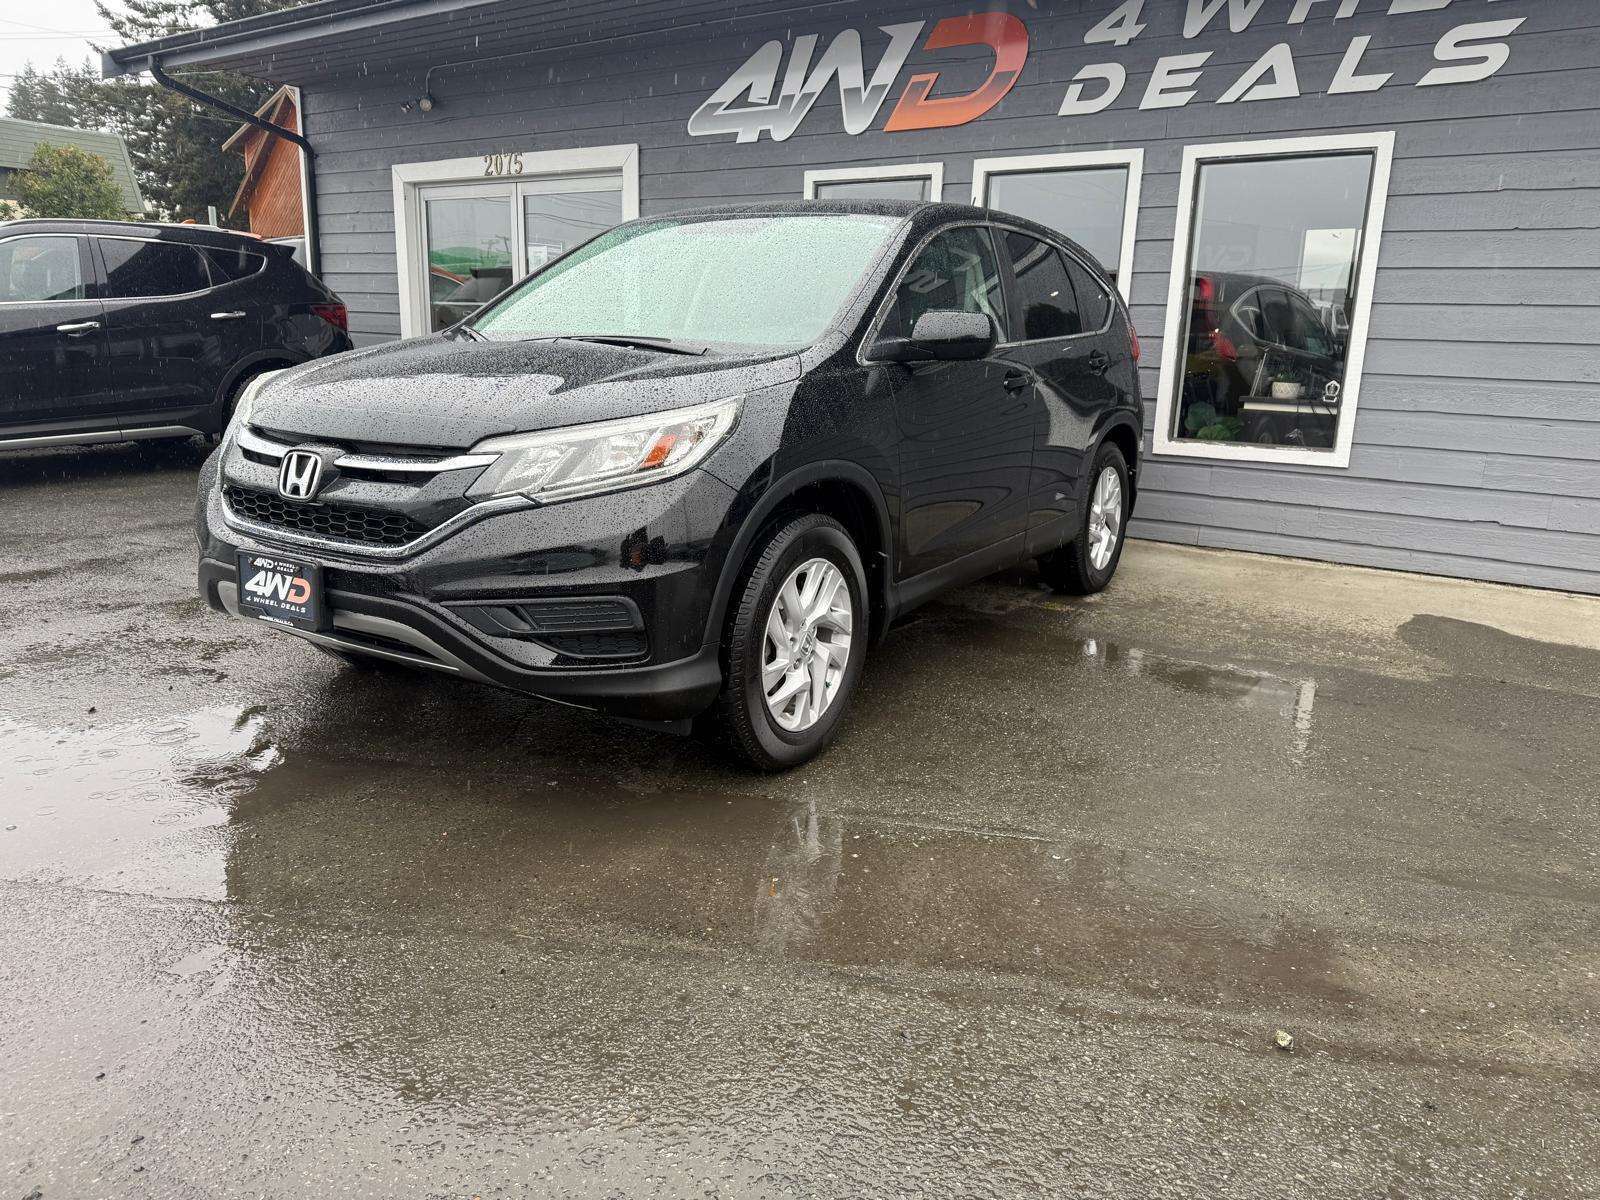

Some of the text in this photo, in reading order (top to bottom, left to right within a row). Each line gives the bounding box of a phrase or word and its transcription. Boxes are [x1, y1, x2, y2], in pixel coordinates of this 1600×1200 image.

[1083, 0, 1147, 46] 4
[687, 12, 1029, 143] 4WD
[1058, 17, 1528, 116] DEALS
[483, 153, 524, 177] 2075
[245, 570, 311, 604] 4WD
[253, 596, 279, 607] WHEEL
[280, 603, 306, 613] DEALS
